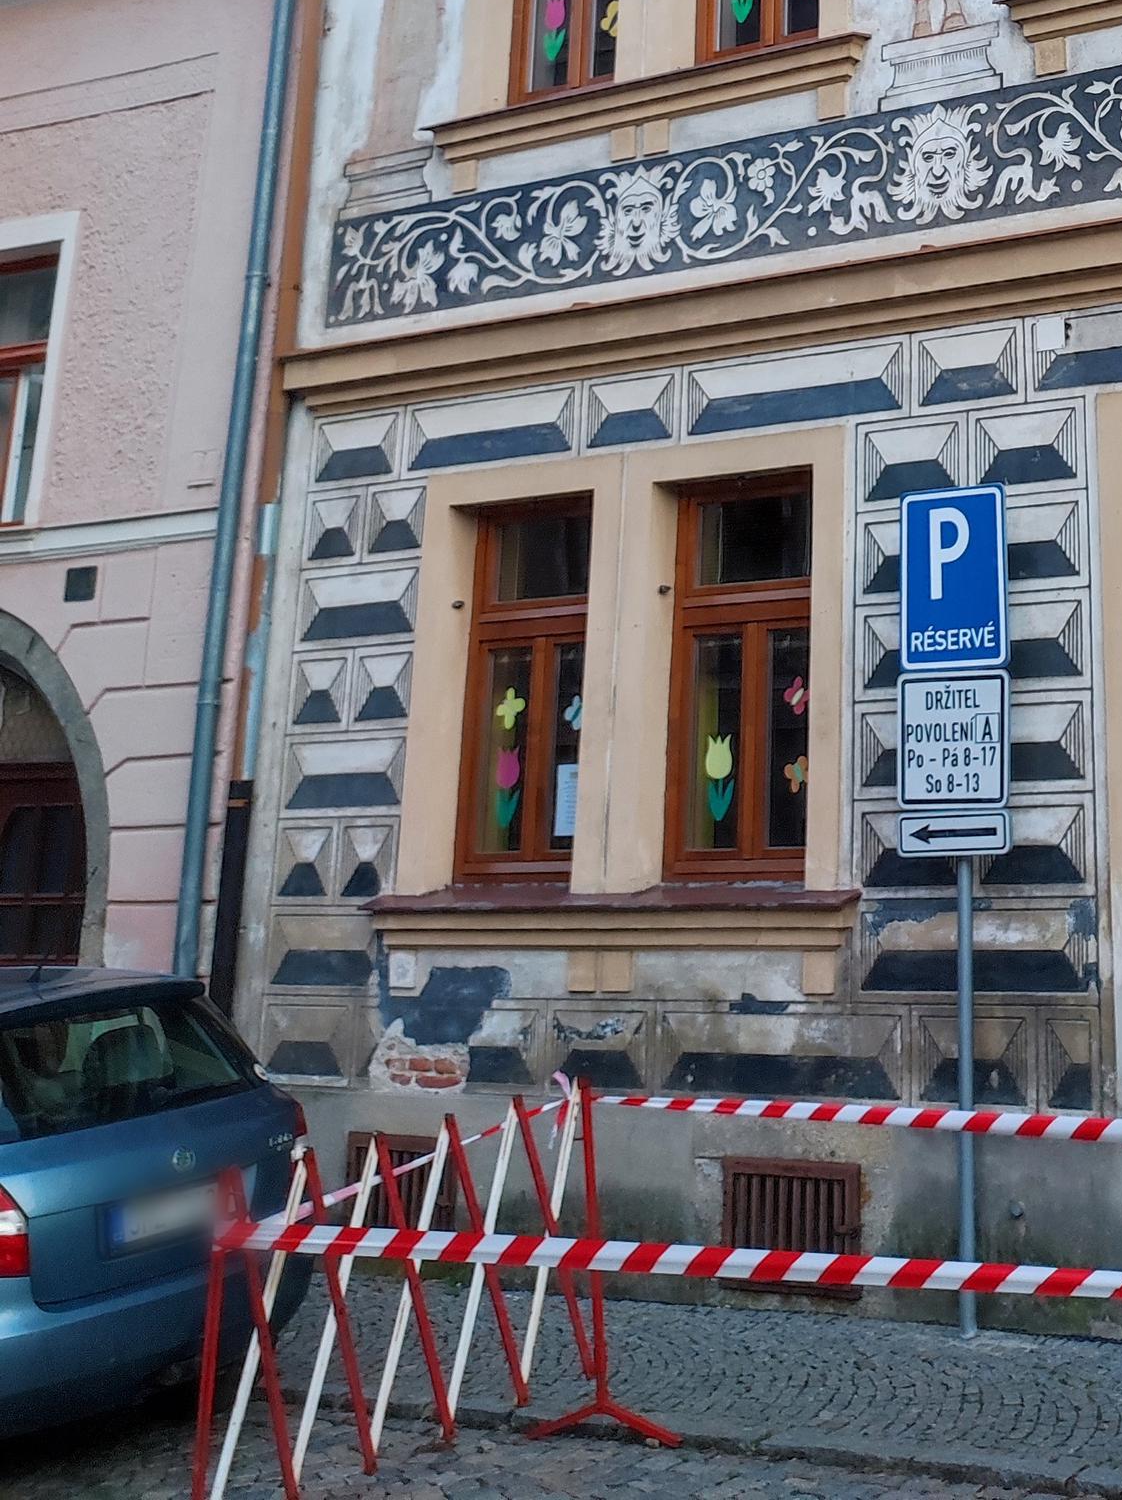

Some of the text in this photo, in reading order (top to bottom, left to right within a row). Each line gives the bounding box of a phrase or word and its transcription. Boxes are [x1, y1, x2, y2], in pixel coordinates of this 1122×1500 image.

[928, 507, 970, 600] P
[911, 621, 996, 652] RÉSERVÉ
[926, 685, 980, 711] DRŽITEL
[906, 715, 993, 743] POVOLENÍ A
[907, 748, 924, 769] Po
[942, 746, 959, 767] Pá
[963, 745, 997, 767] 8-17
[925, 772, 980, 794] So 8-13
